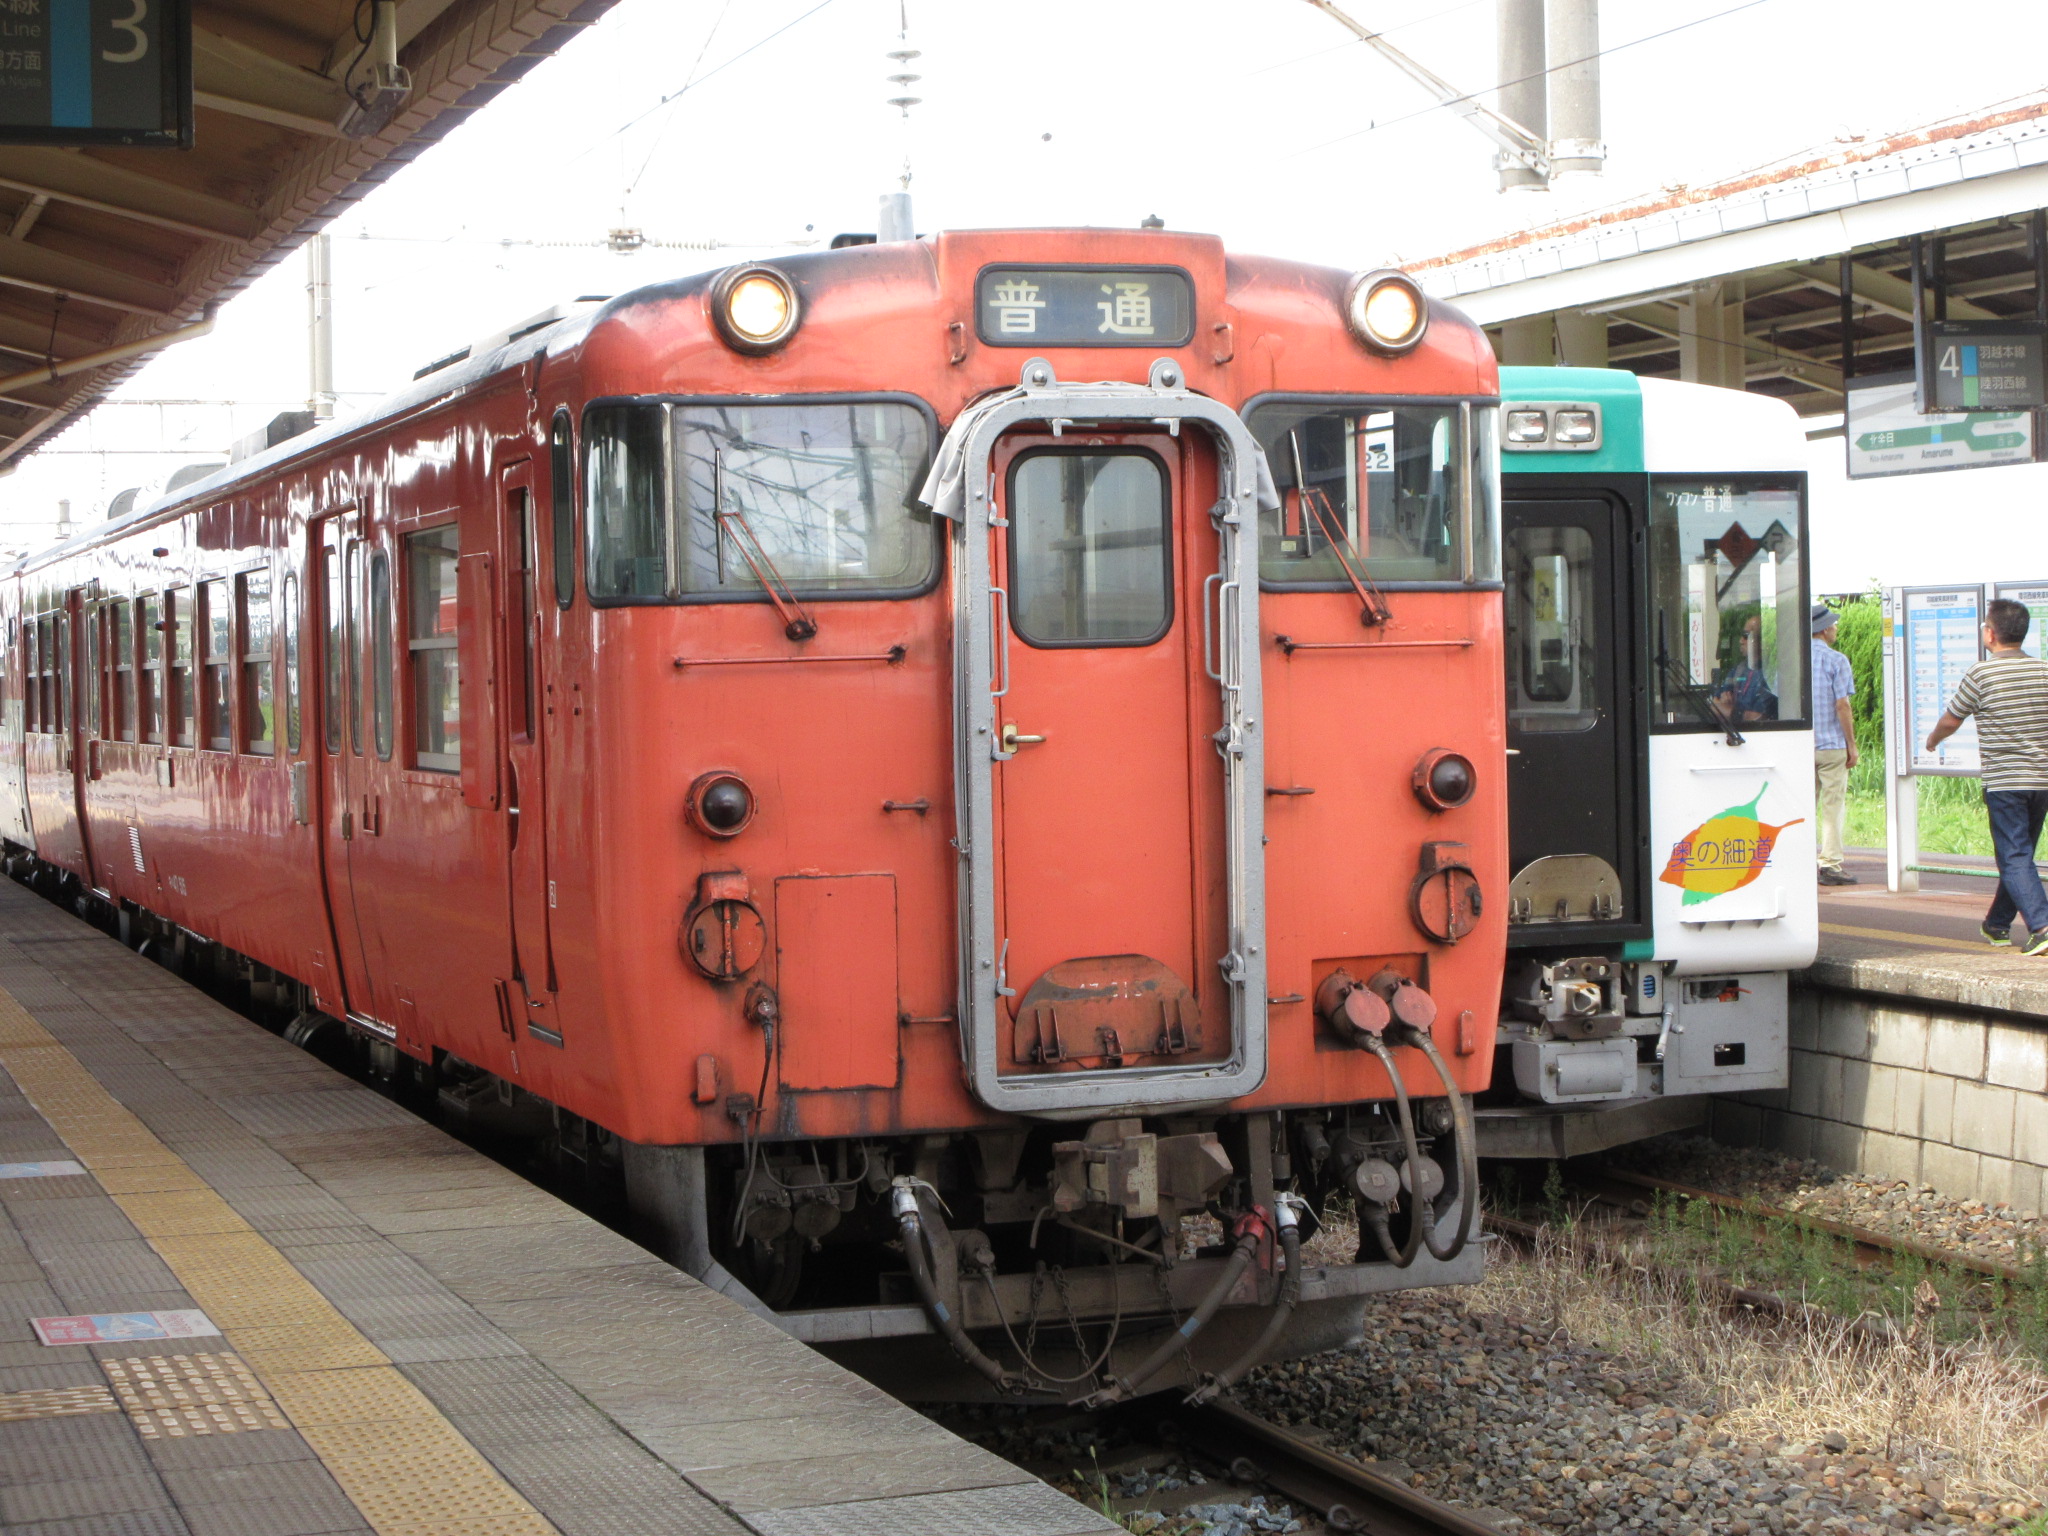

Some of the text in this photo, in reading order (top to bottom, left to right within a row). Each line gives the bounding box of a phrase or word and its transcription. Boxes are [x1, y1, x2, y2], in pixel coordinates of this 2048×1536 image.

[3, 21, 41, 37] Line
[102, 0, 148, 63] 3
[0, 51, 41, 71] 方面
[989, 279, 1155, 335] 普通
[1939, 345, 1960, 378] 4
[1979, 345, 2026, 359] 羽越本線
[1980, 376, 2028, 390] 陸羽西線
[1666, 484, 1734, 513] ワンマン 普通
[1670, 836, 1773, 868] 奥の細道
